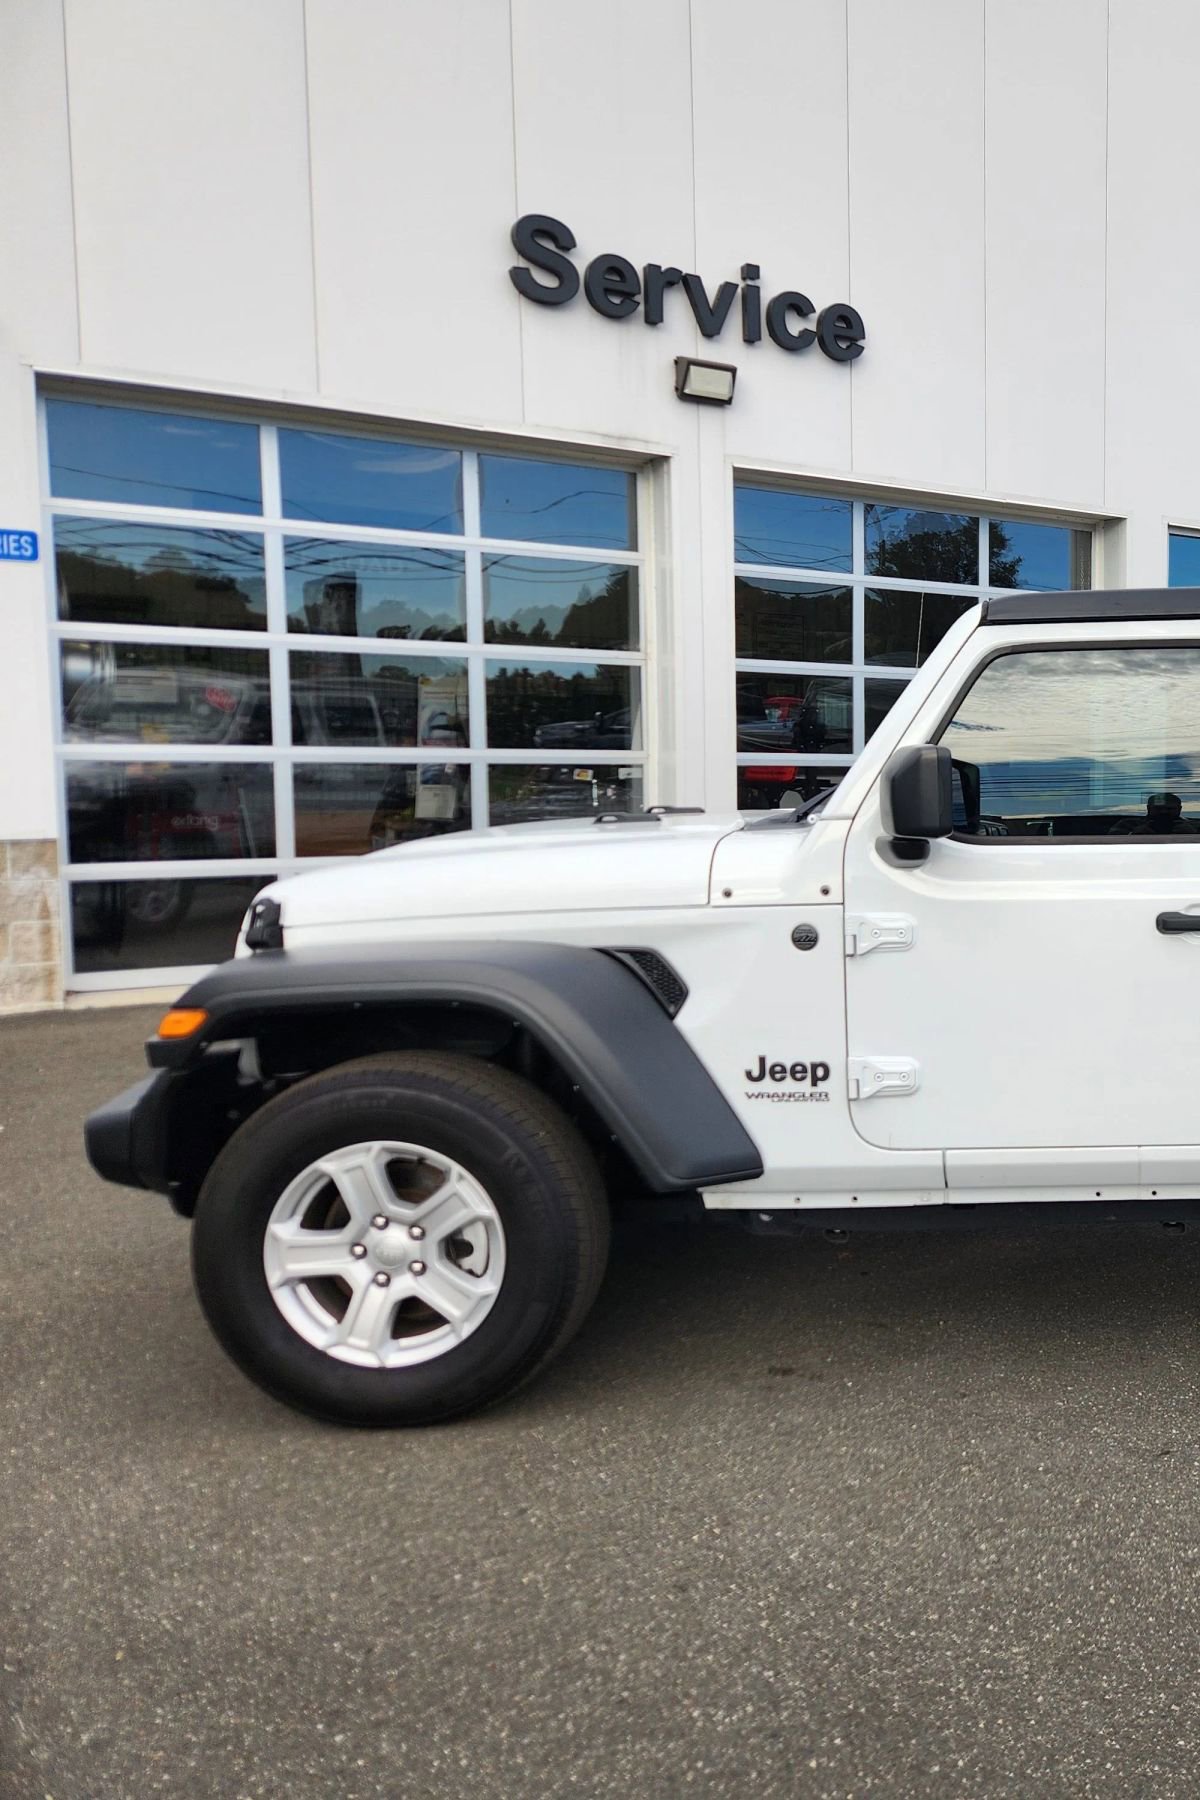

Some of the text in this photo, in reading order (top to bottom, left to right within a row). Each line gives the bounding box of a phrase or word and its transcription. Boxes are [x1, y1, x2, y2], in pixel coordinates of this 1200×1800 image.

[509, 213, 866, 362] Service
[0, 534, 33, 557] IES
[744, 1055, 830, 1087] Jeep
[744, 1091, 829, 1099] WRANGLER
